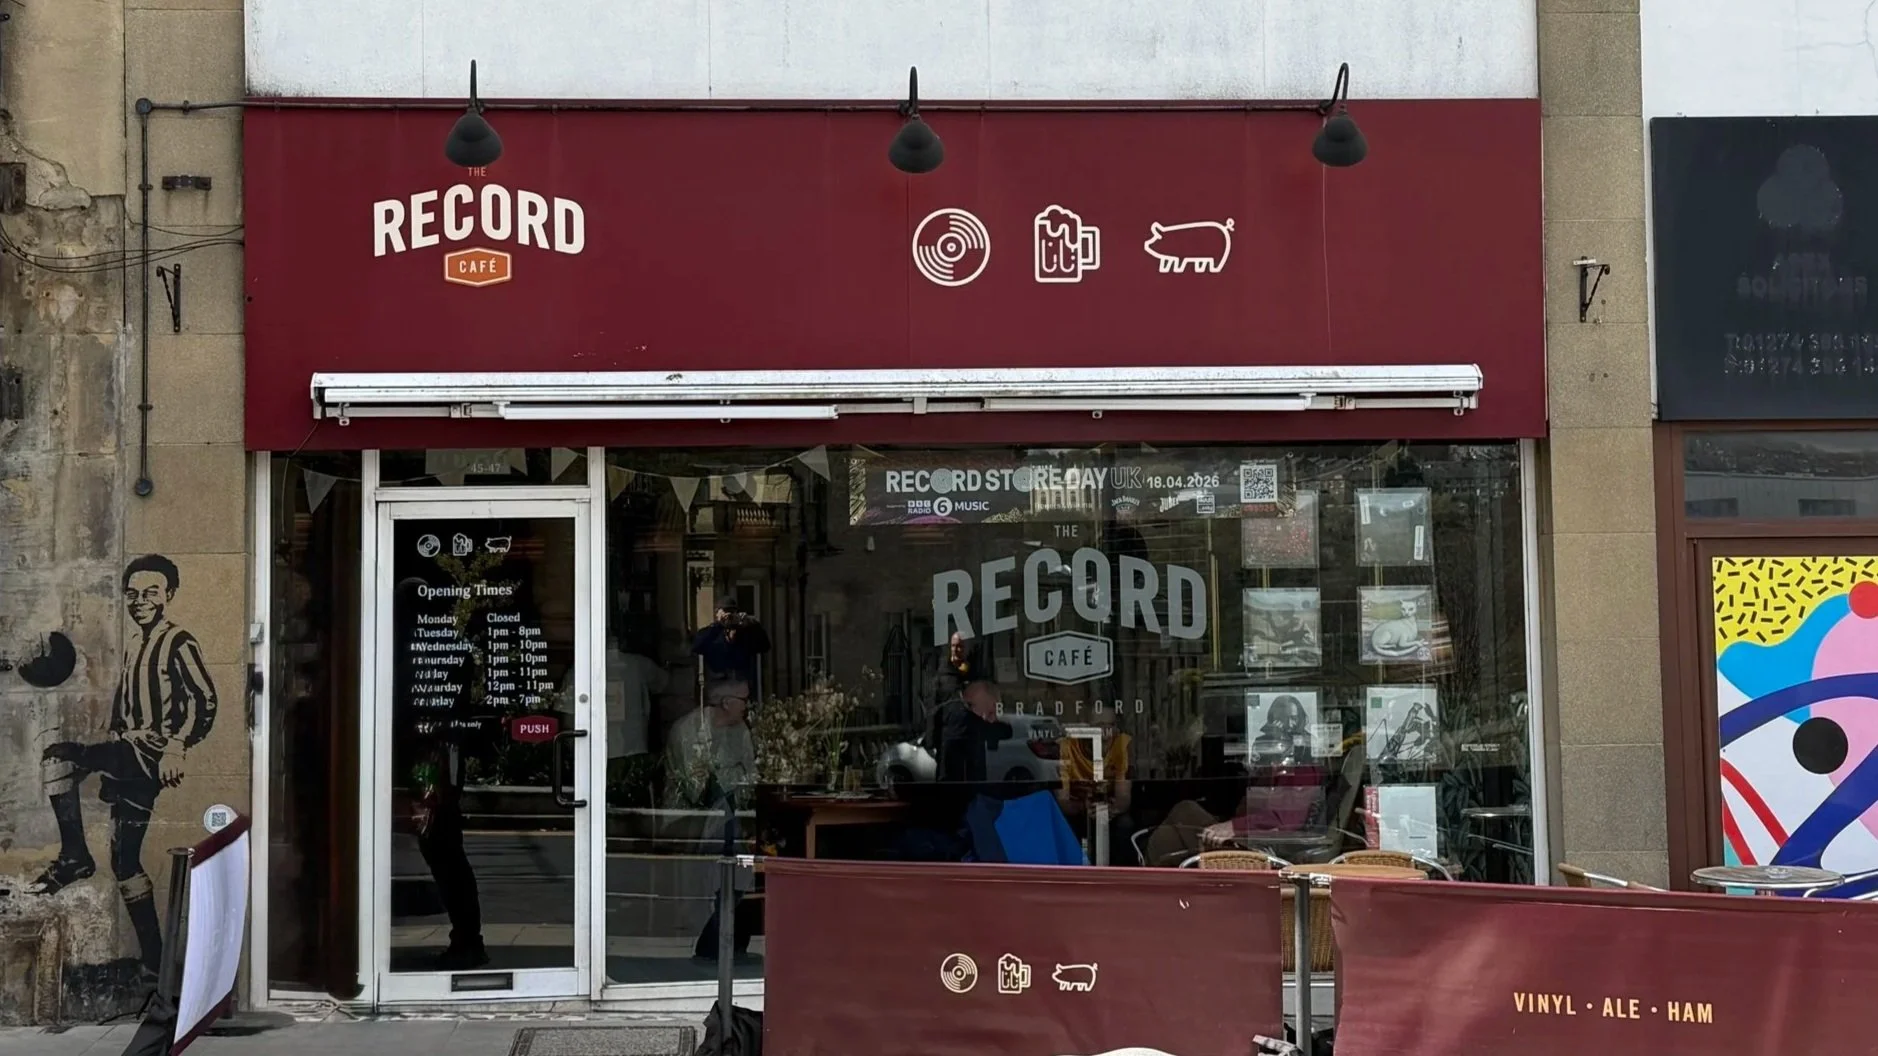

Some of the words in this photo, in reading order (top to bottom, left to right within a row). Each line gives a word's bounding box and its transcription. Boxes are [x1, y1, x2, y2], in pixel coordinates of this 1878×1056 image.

[467, 166, 487, 177] THE
[373, 183, 585, 257] RECORD
[459, 257, 497, 273] CAFÉ
[470, 463, 501, 473] 45-47
[886, 468, 982, 494] RECORD
[984, 465, 1062, 492] STORE
[1066, 466, 1108, 490] DAY
[1110, 466, 1143, 489] UK
[1146, 474, 1220, 489] 18.04.2026
[907, 500, 932, 508] BBC
[954, 501, 990, 511] MUSIC
[1054, 524, 1078, 538] THE
[417, 585, 472, 600] Opening
[474, 584, 513, 596] Times
[932, 547, 1208, 647] RECORD
[417, 614, 459, 626] Monday
[486, 612, 521, 623] Closed
[417, 628, 459, 640] Tuesday
[487, 627, 509, 637] 1pm
[518, 626, 541, 637] 8pm
[416, 641, 474, 653] Wednesday
[487, 640, 509, 651] 1pm
[519, 639, 548, 651] 10pm
[415, 654, 465, 667] ursday
[487, 654, 509, 664] 1pm
[519, 653, 548, 664] 10pm
[1044, 645, 1093, 666] CAFÉ
[487, 668, 509, 678] 1pm
[519, 667, 548, 678] 11pm
[414, 682, 463, 694] urday
[487, 681, 516, 692] 12pm
[526, 680, 554, 692] 11pm
[486, 695, 509, 705] 2pm
[519, 694, 541, 705] 7pm
[995, 699, 1144, 717] BRADFORD
[519, 724, 550, 734] PUSH
[1028, 729, 1055, 739] VINYL
[1513, 991, 1577, 1015] VINYL
[1602, 997, 1641, 1019] ALE
[1667, 1001, 1713, 1024] HAM
